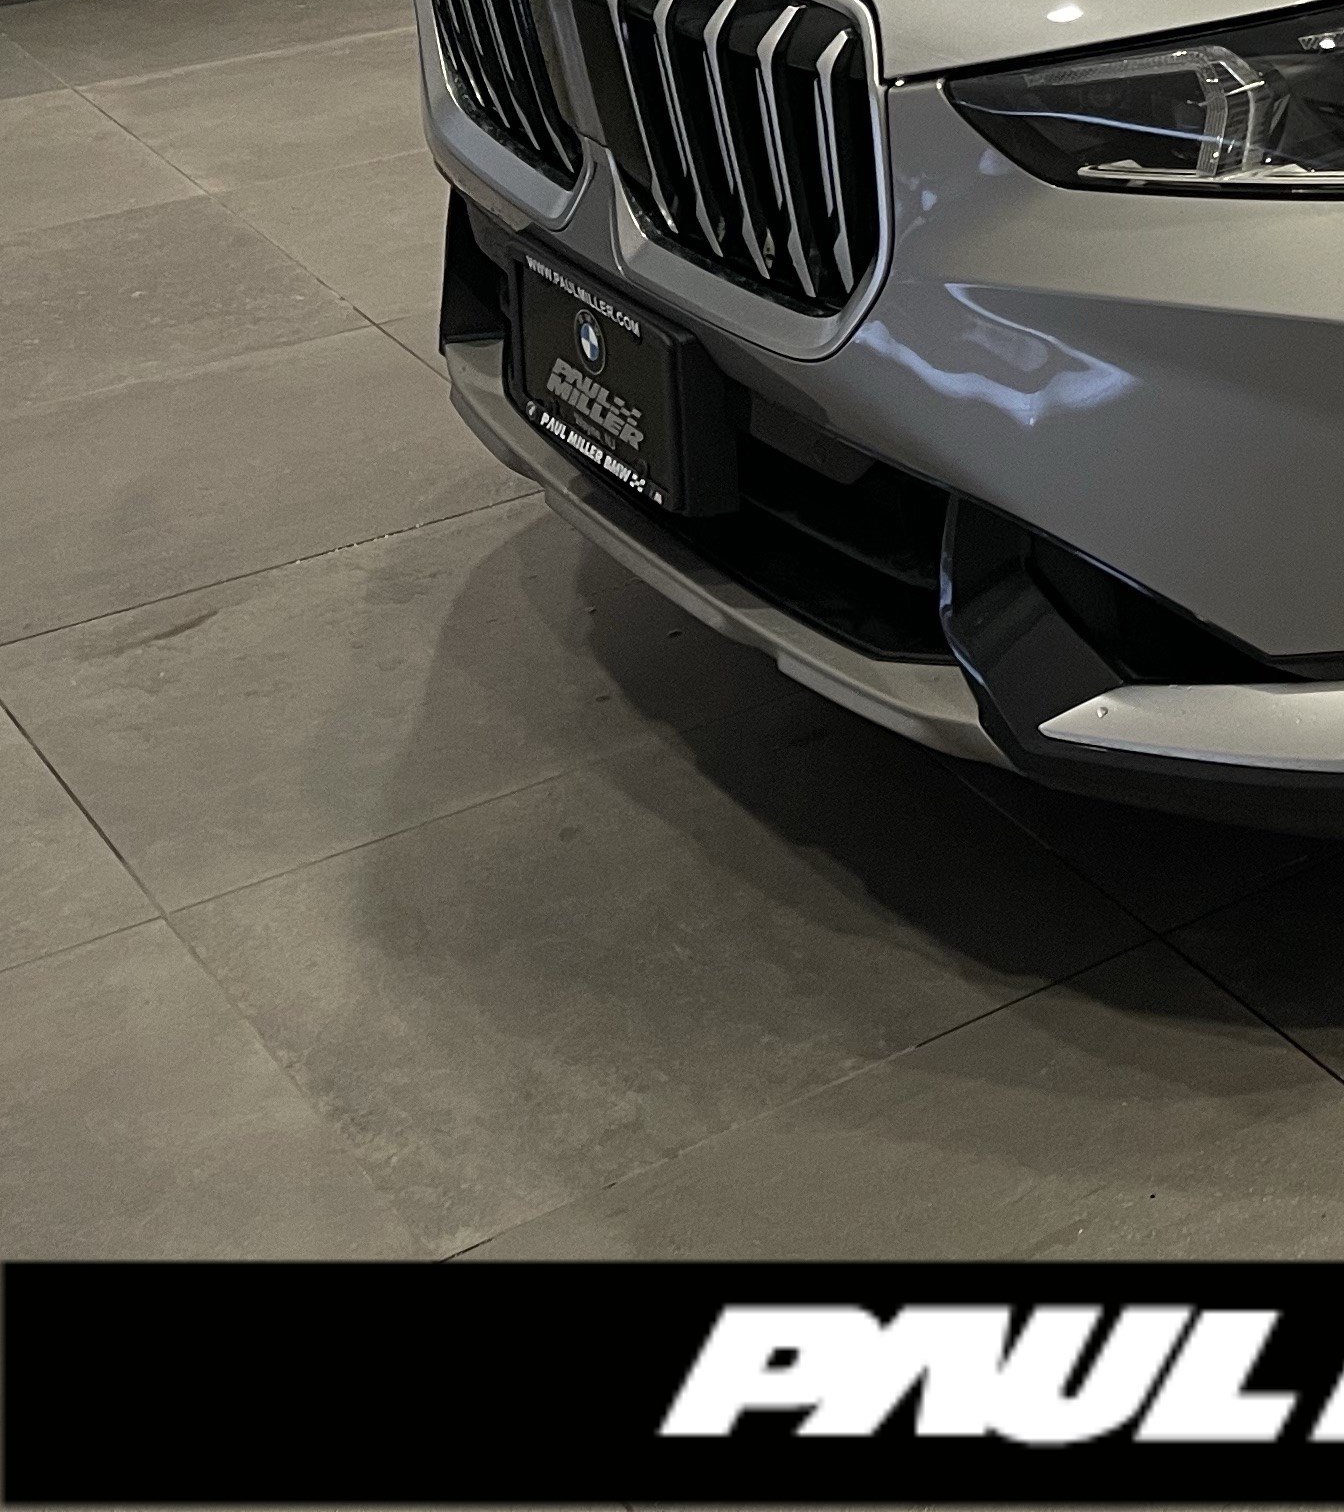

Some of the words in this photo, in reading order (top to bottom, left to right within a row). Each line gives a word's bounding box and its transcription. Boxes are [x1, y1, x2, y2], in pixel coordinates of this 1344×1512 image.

[547, 372, 644, 450] MILLER
[550, 357, 612, 408] PAUL
[540, 412, 567, 440] PAUL
[566, 431, 604, 465] MILLER
[603, 455, 632, 483] BMW
